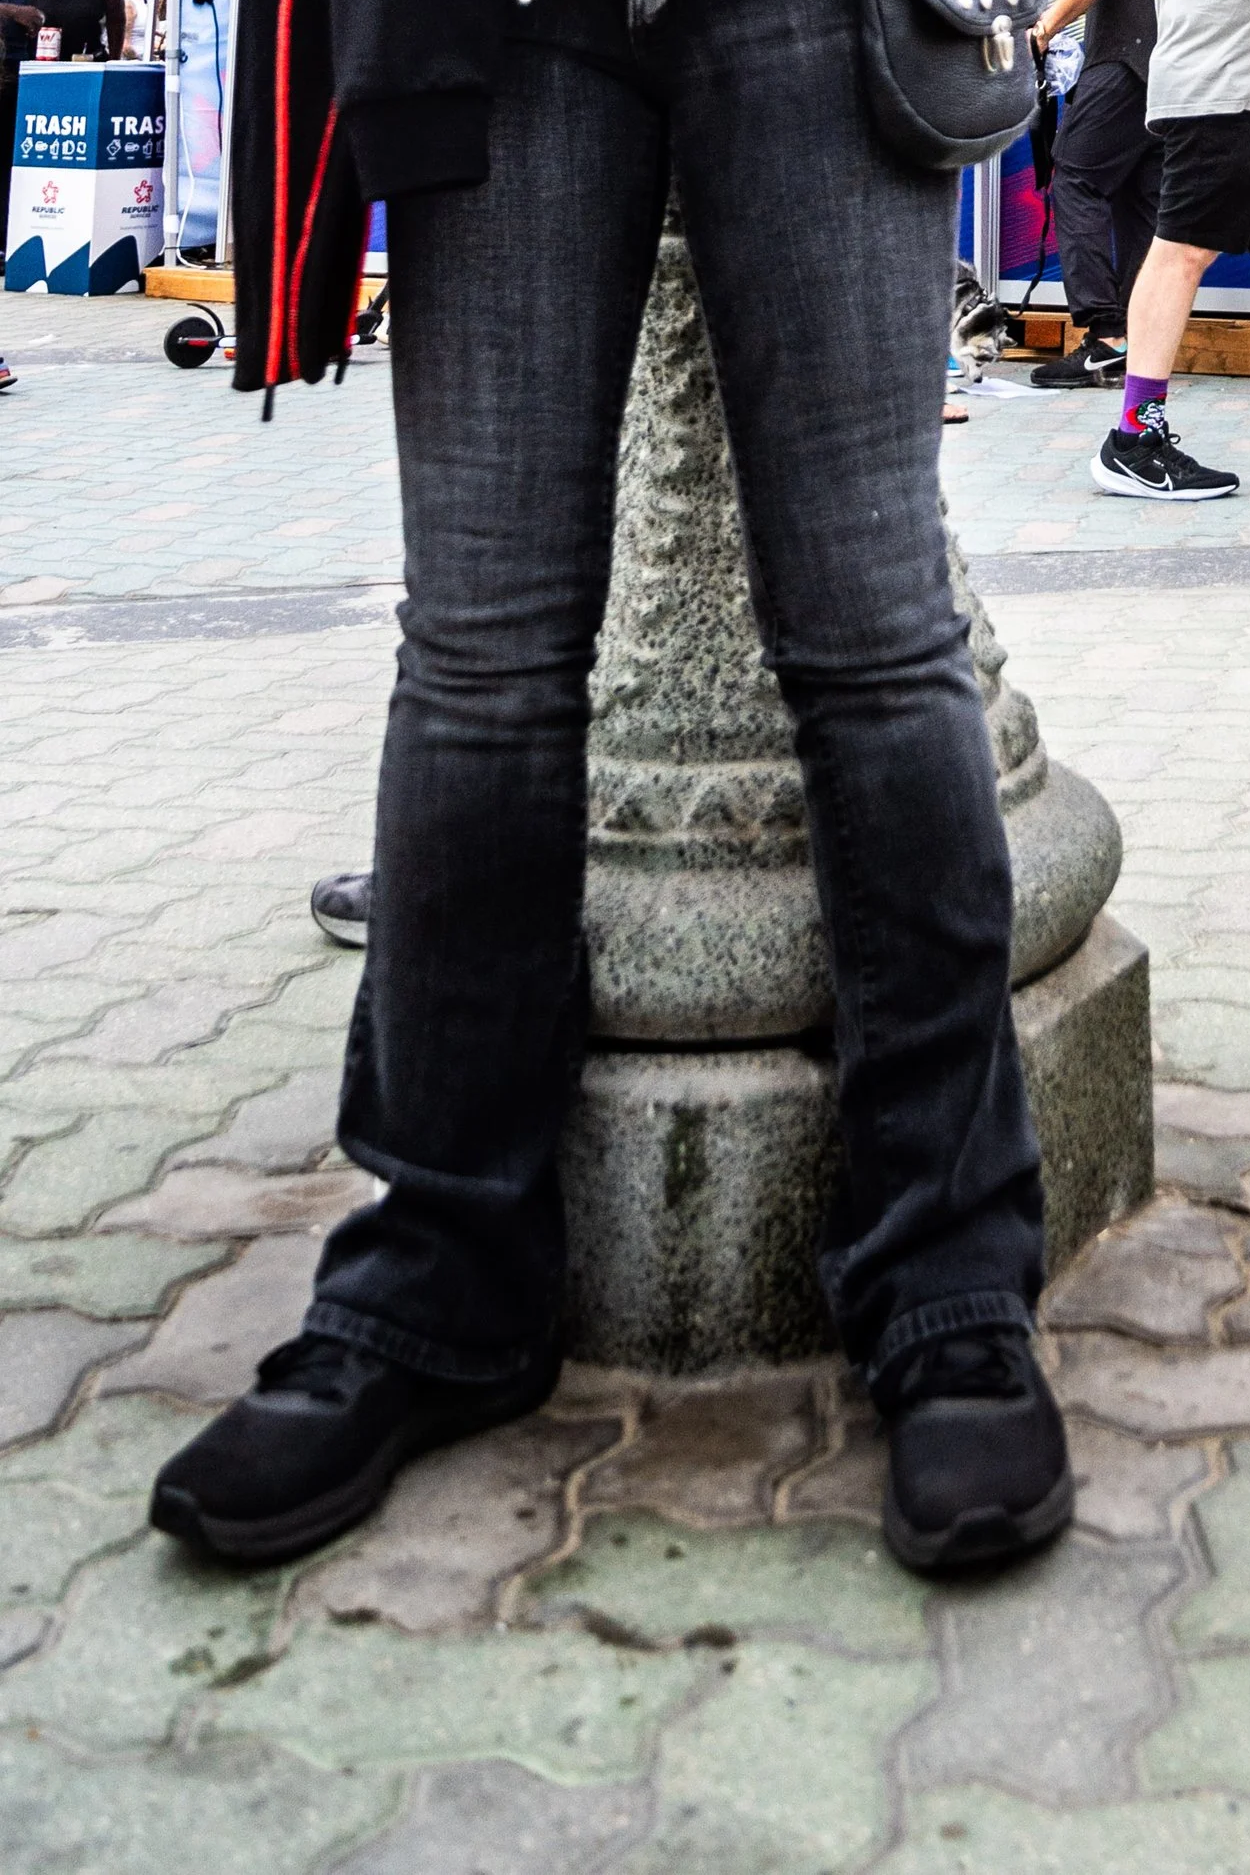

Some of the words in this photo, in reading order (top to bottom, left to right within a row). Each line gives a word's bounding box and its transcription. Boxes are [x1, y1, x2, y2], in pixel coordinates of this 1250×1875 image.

[25, 115, 86, 136] TRASH
[111, 116, 164, 136] TRAS
[32, 206, 66, 214] REPUBLIC
[121, 205, 159, 214] REPUBLIC
